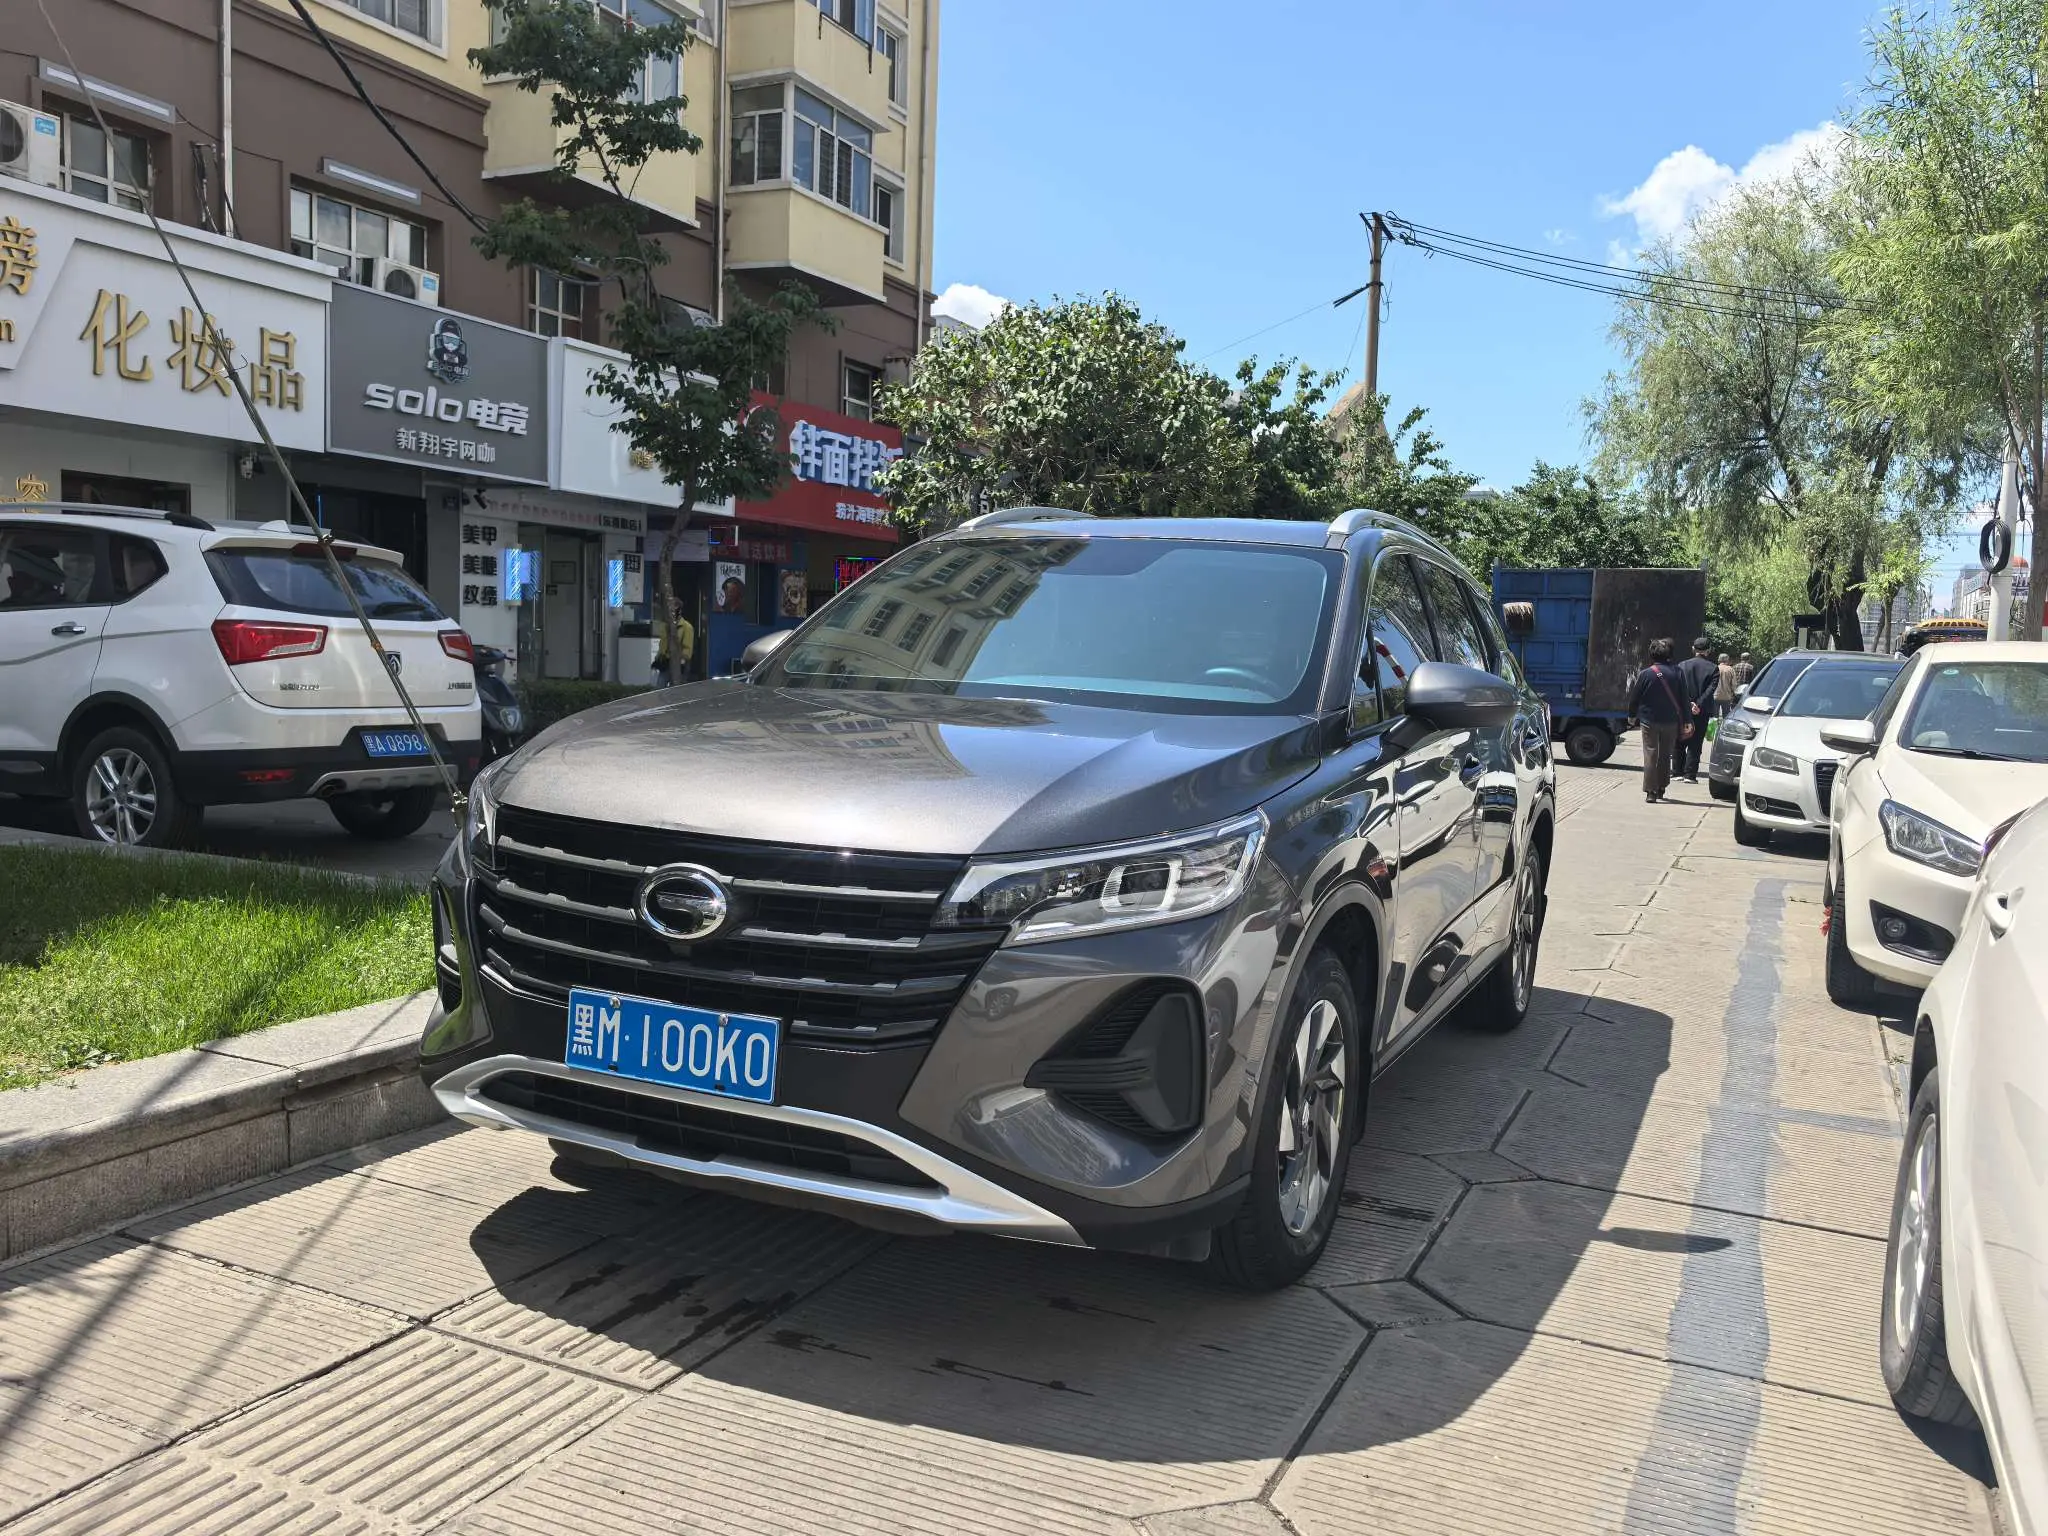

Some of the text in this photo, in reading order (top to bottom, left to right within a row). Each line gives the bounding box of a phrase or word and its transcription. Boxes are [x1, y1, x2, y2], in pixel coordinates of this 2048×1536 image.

[80, 288, 305, 412] 化妆品
[396, 427, 496, 463] 新翔宇网咖
[462, 524, 497, 546] 美甲
